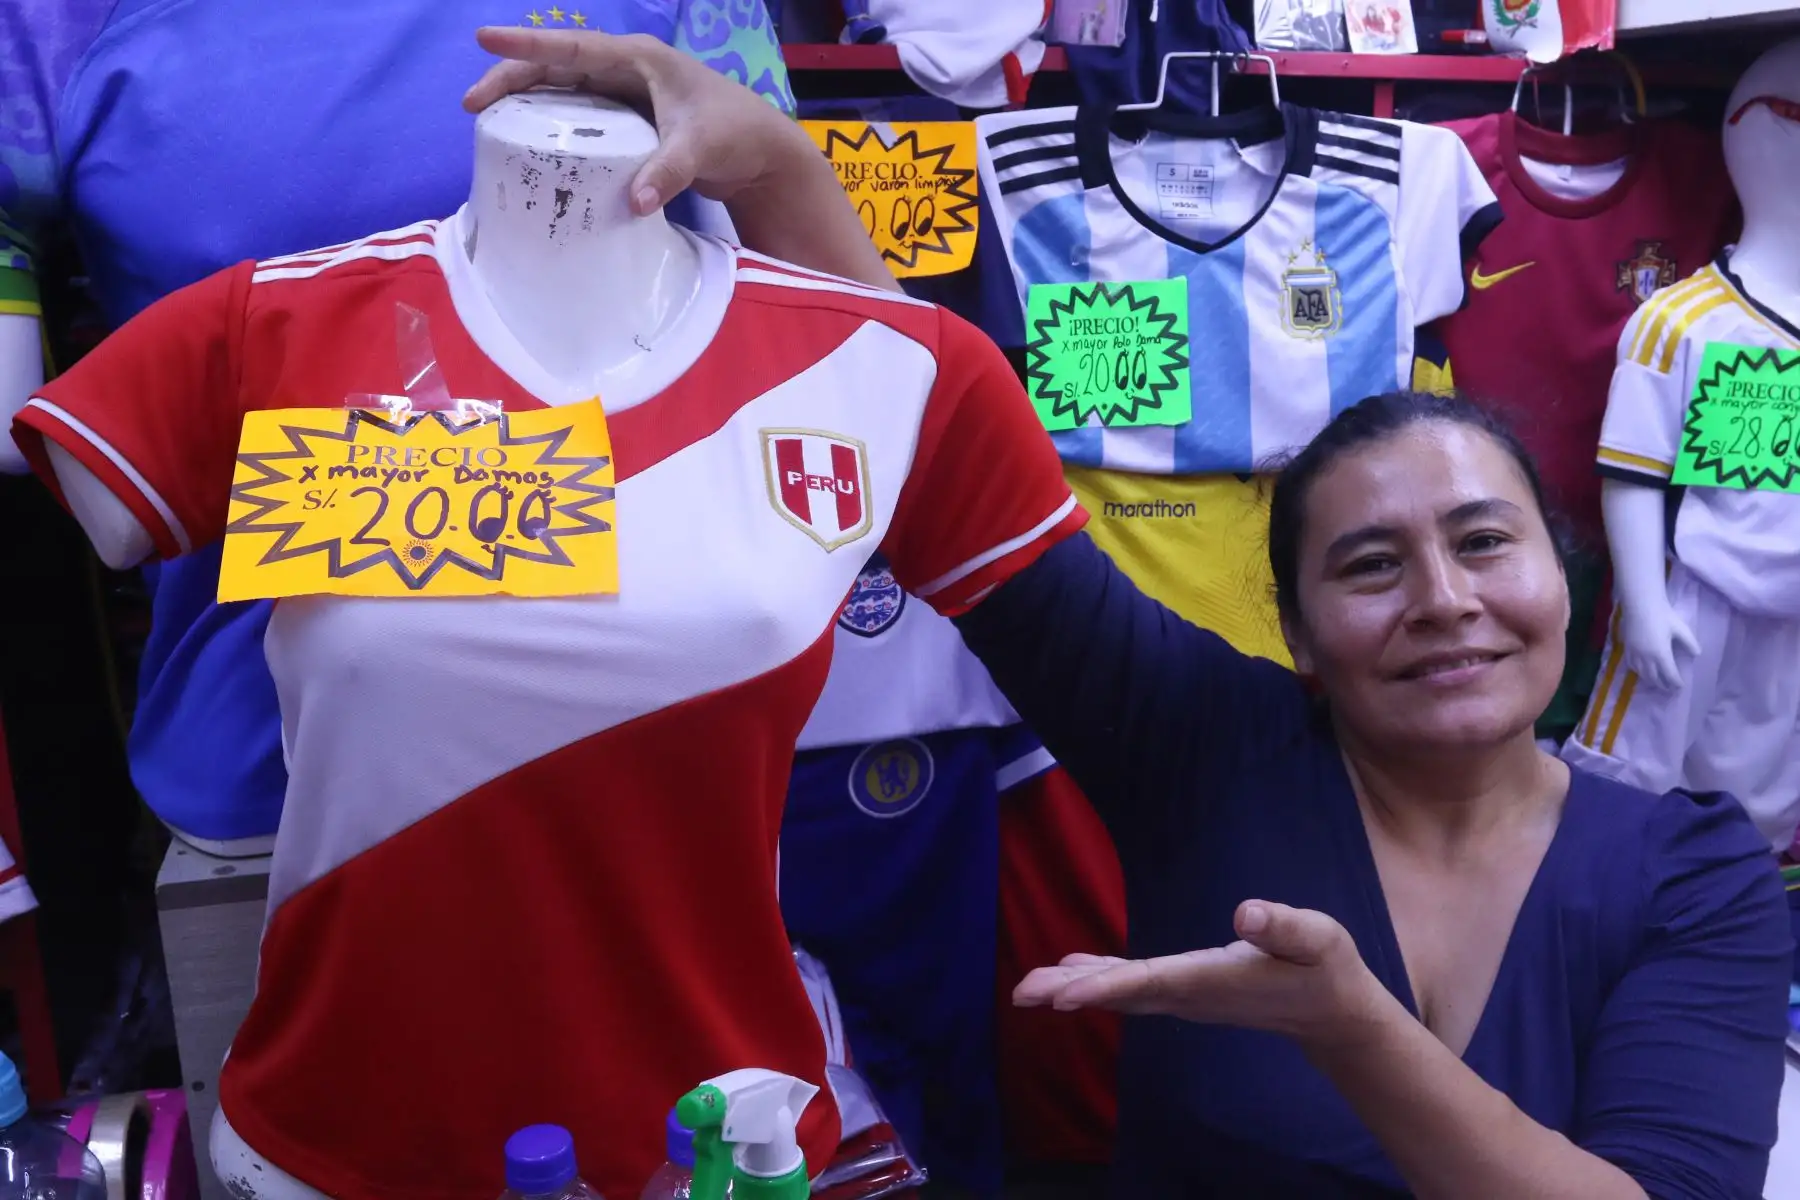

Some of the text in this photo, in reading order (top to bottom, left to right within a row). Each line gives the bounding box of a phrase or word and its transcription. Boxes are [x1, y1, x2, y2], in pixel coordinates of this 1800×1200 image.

[830, 162, 917, 181] PRECIO
[857, 196, 935, 240] 0.00
[1293, 287, 1329, 322] AFA
[1069, 316, 1139, 336] ¡PRECIO!
[1073, 339, 1107, 355] mayor
[1113, 335, 1131, 349] Polo
[1721, 399, 1768, 416] mayor
[345, 444, 507, 467] PRECIO
[328, 465, 430, 488] mayor
[454, 464, 554, 489] Damas
[786, 470, 854, 494] PERU
[302, 488, 338, 510] S/.
[1103, 499, 1196, 517] marathon
